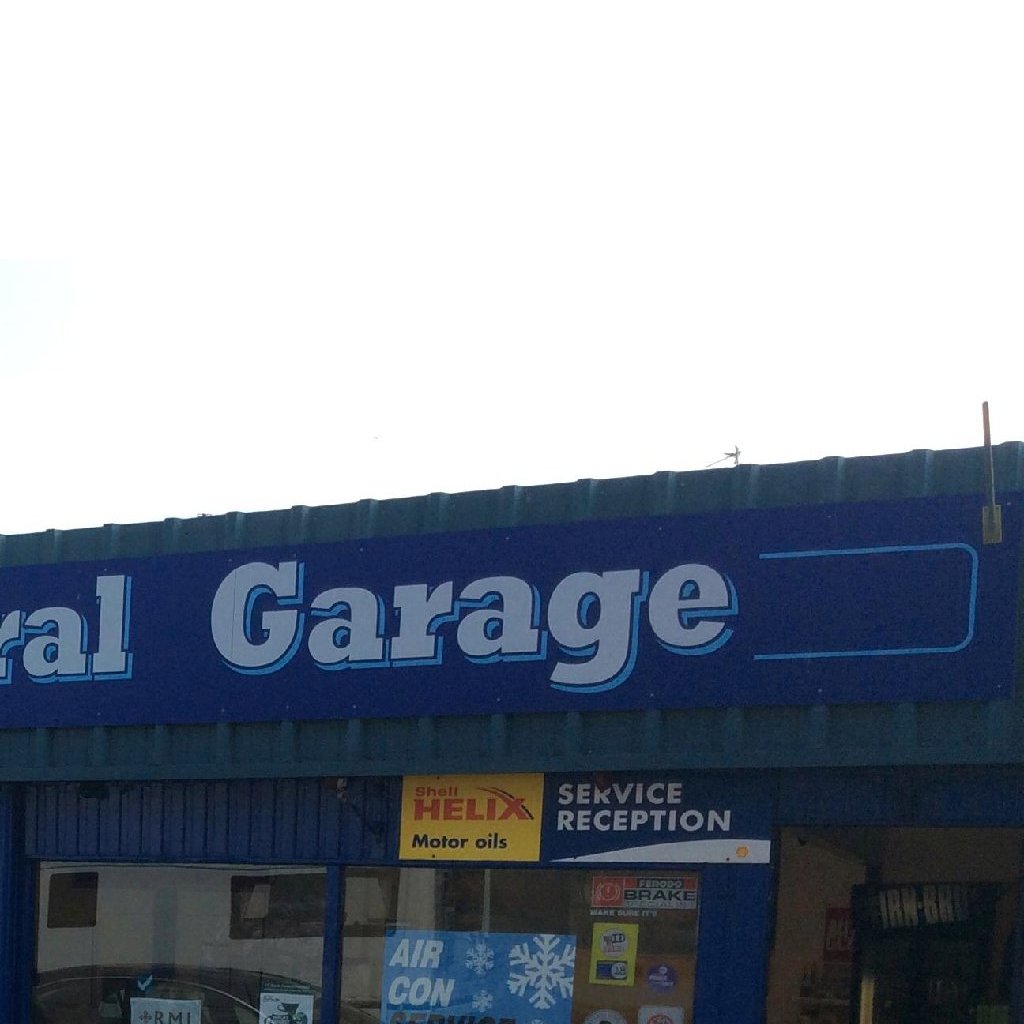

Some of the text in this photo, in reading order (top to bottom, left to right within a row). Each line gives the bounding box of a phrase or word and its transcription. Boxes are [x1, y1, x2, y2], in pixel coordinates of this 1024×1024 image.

[211, 561, 739, 693] Garage
[415, 786, 458, 797] Shell
[557, 783, 683, 806] SERVICE
[413, 797, 534, 821] HELIX
[557, 809, 732, 832] RECEPTION
[411, 832, 508, 850] Motor oils
[623, 889, 696, 901] BRAKE
[388, 938, 444, 968] AIR
[388, 976, 455, 1007] CON
